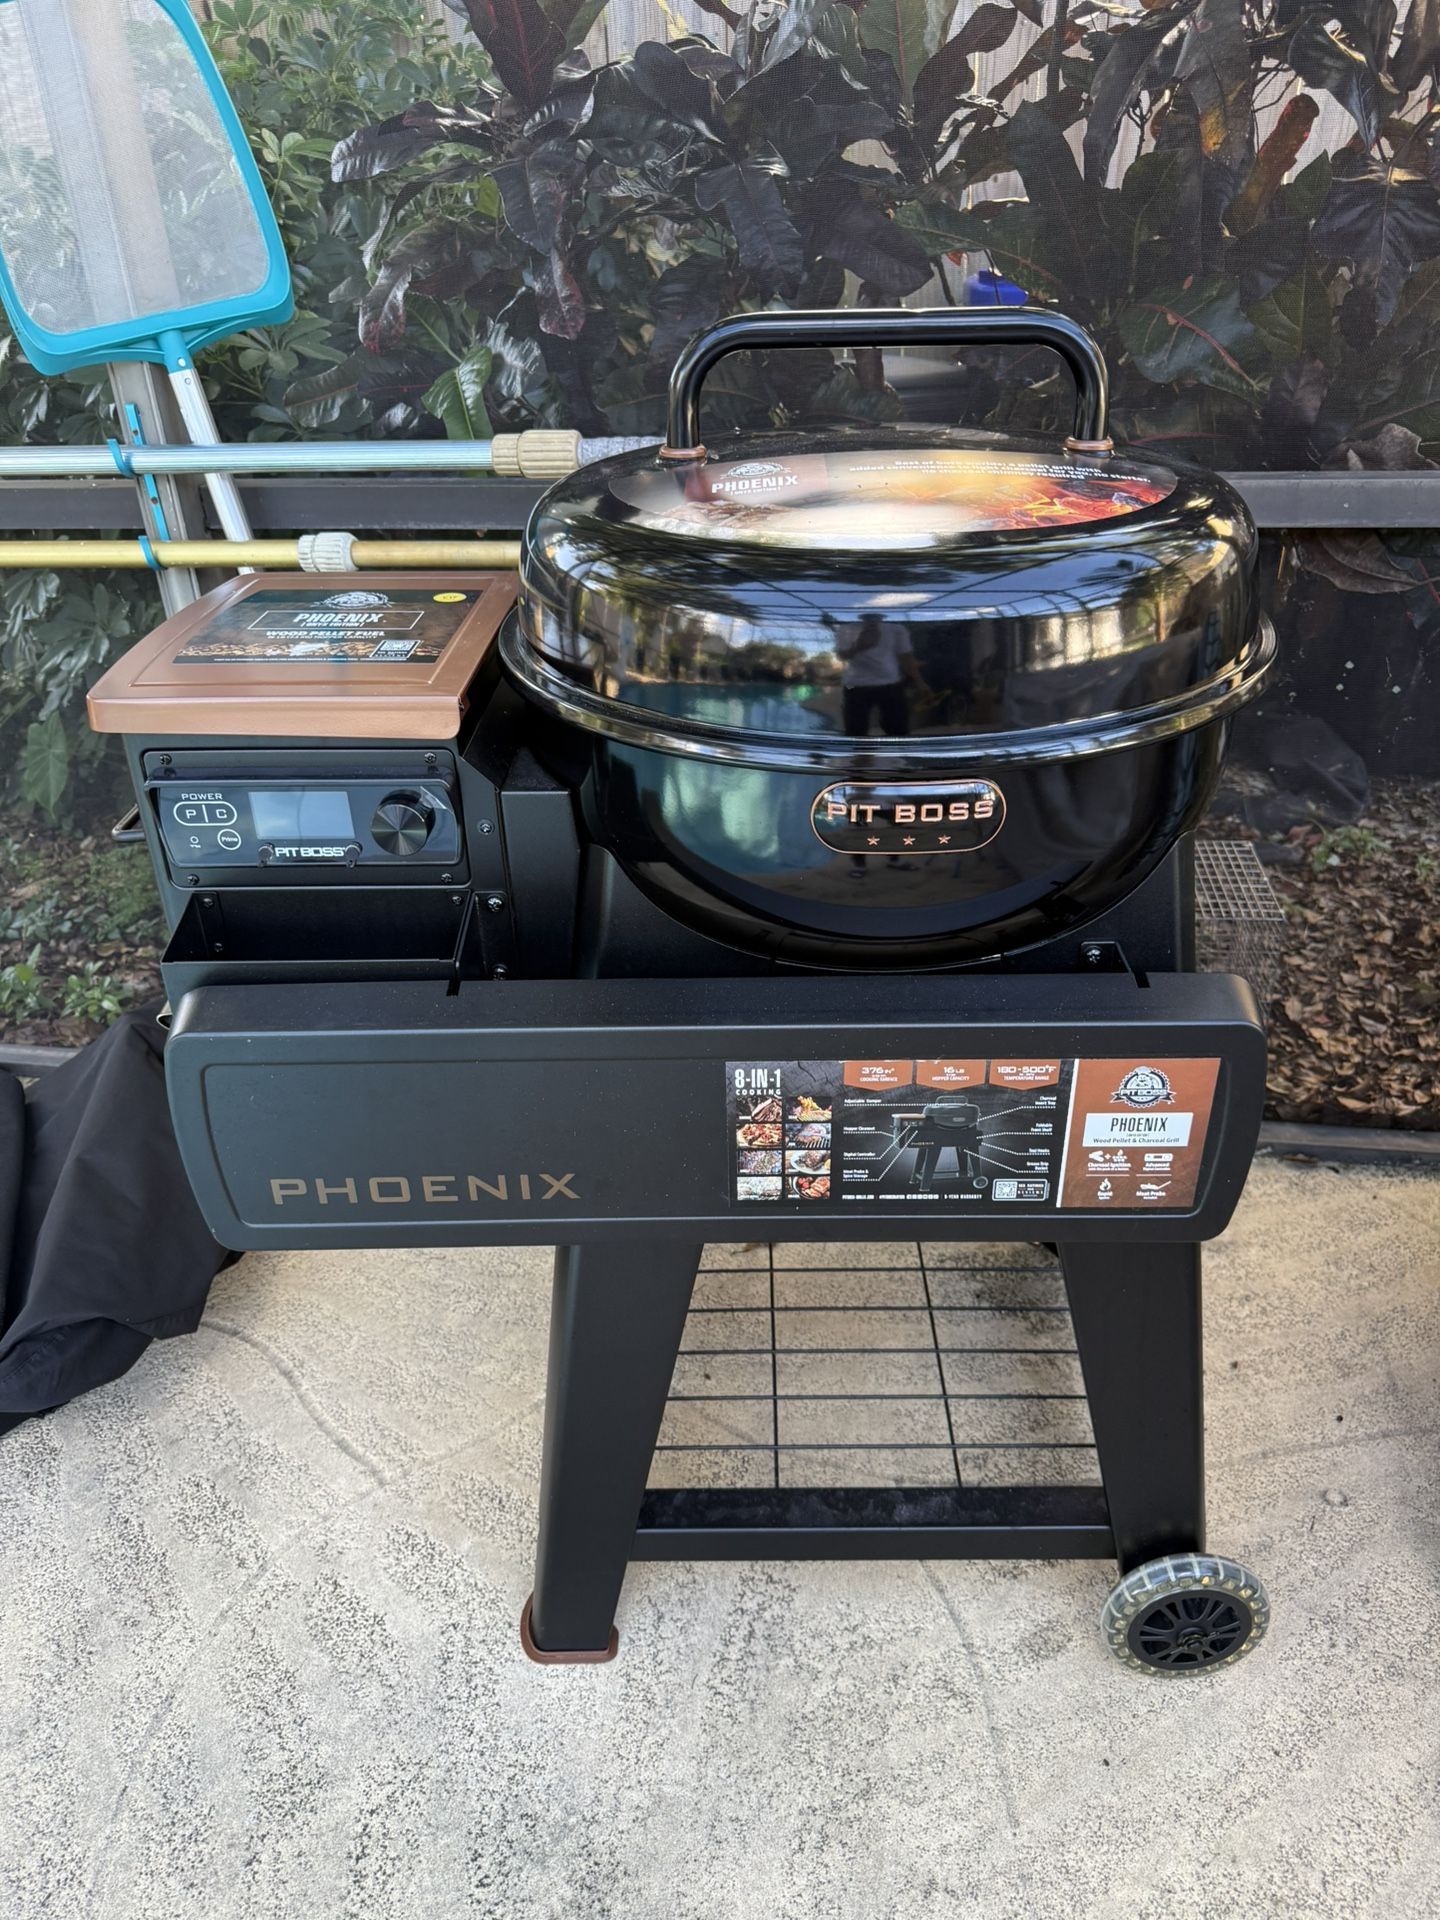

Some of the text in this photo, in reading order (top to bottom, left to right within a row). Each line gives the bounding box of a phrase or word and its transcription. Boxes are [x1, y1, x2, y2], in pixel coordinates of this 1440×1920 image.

[712, 475, 798, 493] PHOENIX
[293, 613, 384, 623] PHOENIX
[181, 793, 223, 801] POWER
[186, 808, 228, 819] P C
[827, 799, 994, 823] PIT BOSS
[275, 847, 345, 857] PIT BOSS
[861, 1066, 884, 1074] 376
[944, 1066, 954, 1074] 16
[735, 1068, 781, 1088] 8-IN-1
[1110, 1117, 1168, 1132] PHOENIX
[269, 1173, 582, 1206] PHOENIX
